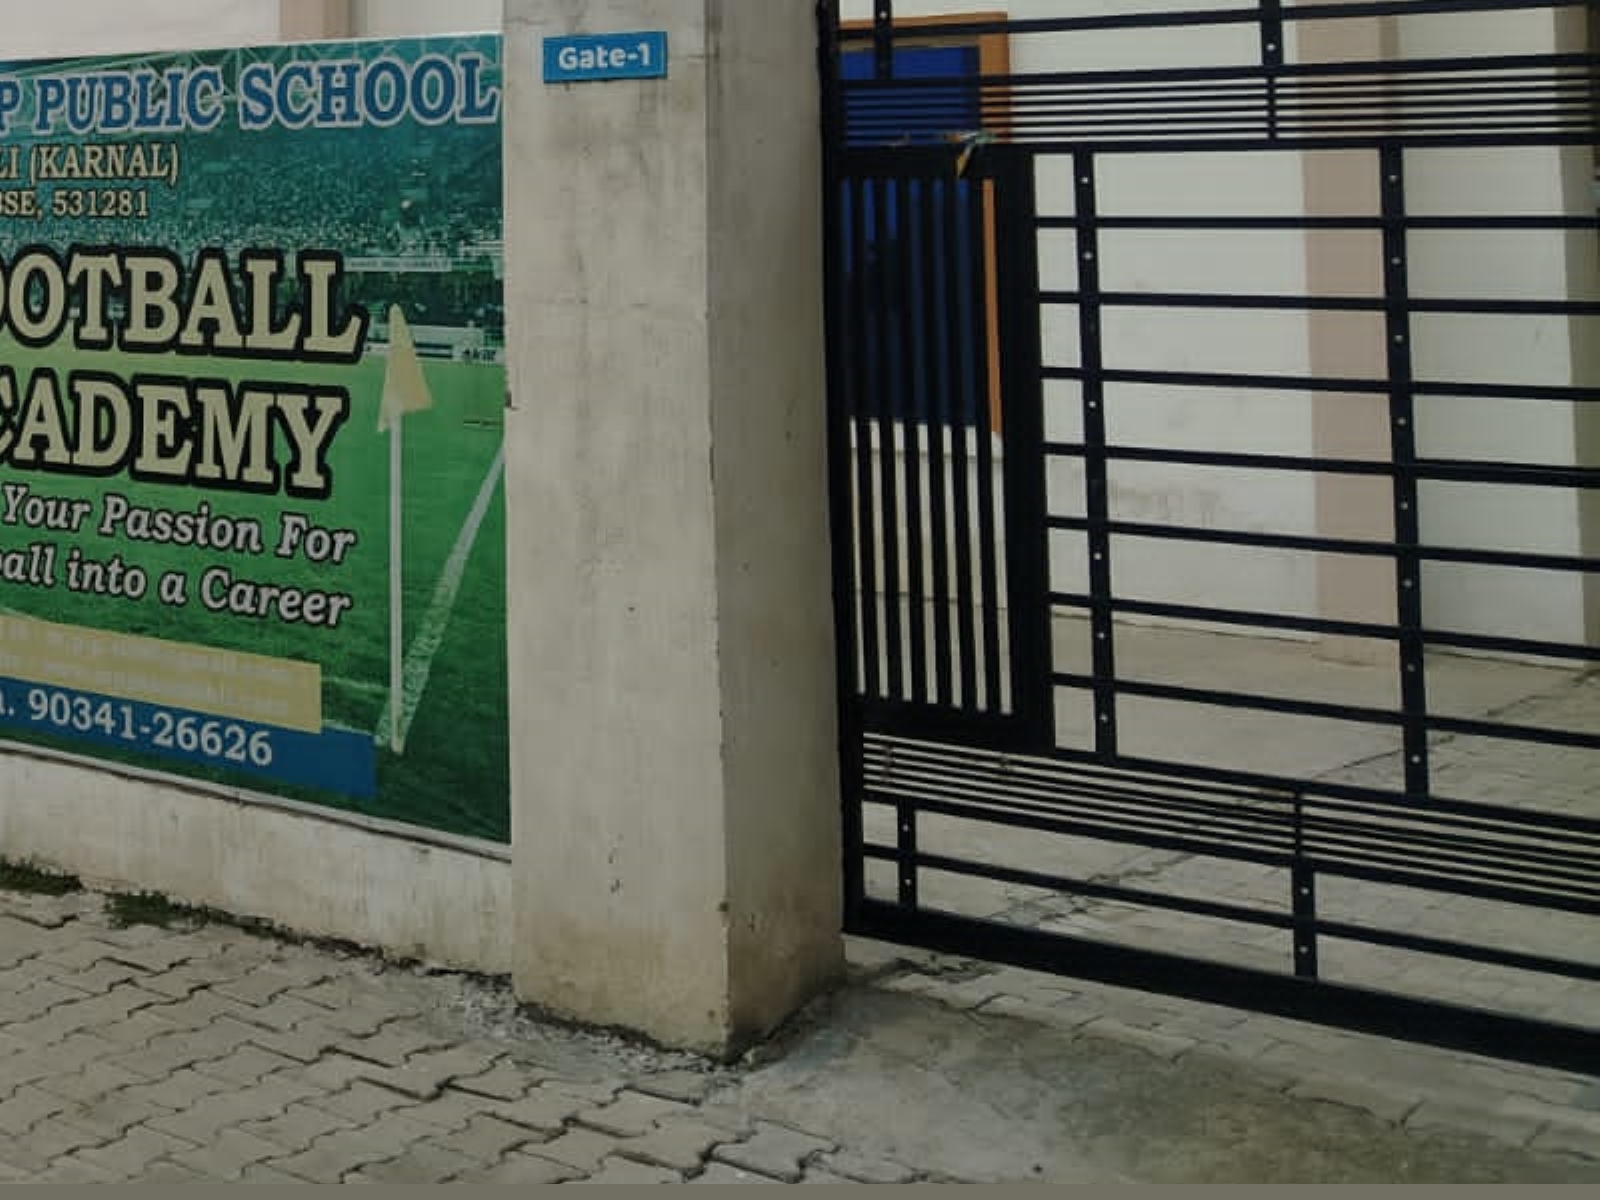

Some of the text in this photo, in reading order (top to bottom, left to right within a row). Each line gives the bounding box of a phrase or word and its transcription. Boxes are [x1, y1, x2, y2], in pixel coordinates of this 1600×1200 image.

[35, 64, 224, 132] PUBLIC
[239, 54, 501, 126] SCHOOL
[558, 42, 650, 70] Gate-1
[30, 142, 178, 186] (KARNAL)
[52, 189, 148, 217] 531281
[2, 484, 92, 534] Your
[100, 494, 263, 553] Passion
[277, 513, 357, 563] For
[67, 550, 147, 599] into
[159, 572, 186, 605] a
[200, 568, 352, 626] Career
[27, 687, 275, 768] 90341-26626
